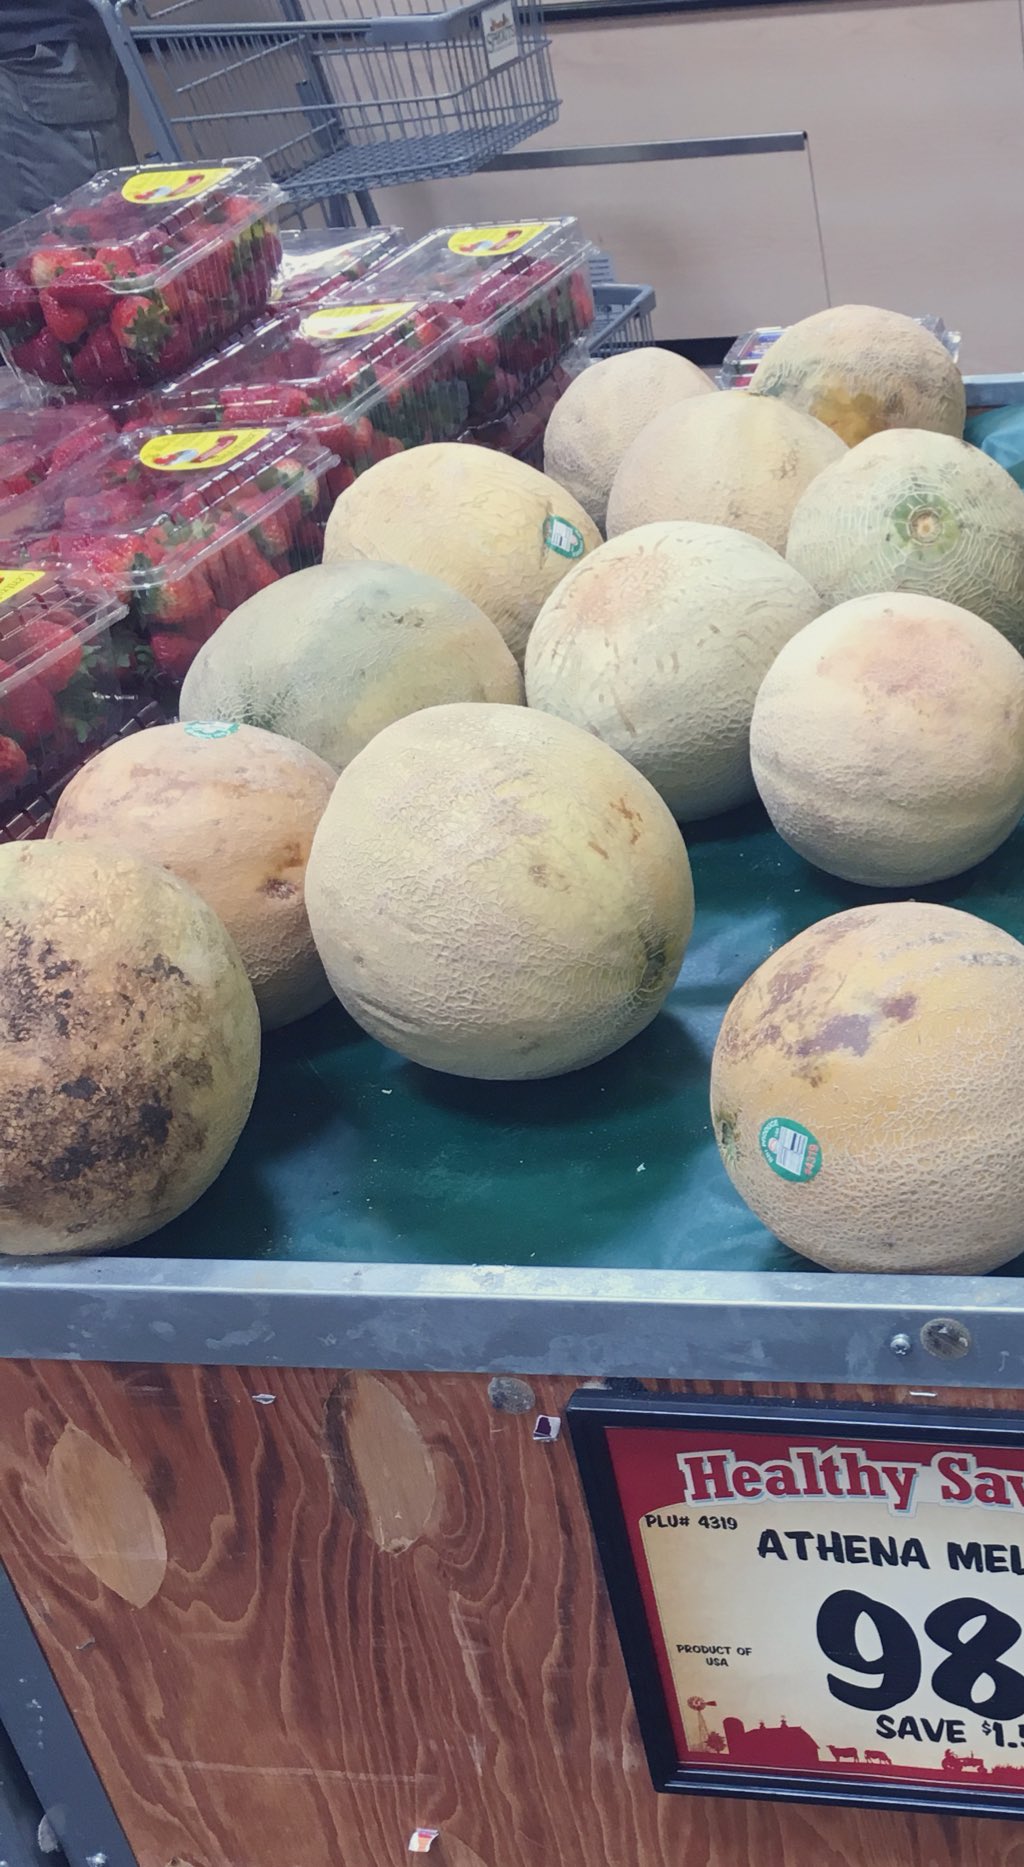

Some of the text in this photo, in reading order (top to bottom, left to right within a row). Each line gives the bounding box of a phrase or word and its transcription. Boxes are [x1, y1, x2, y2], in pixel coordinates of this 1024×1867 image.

[683, 1450, 919, 1512] Healthy
[644, 1514, 738, 1530] PLU# 4319
[756, 1529, 931, 1569] ATHENA
[676, 1644, 752, 1656] PRODUCT OF
[705, 1657, 729, 1667] USA
[875, 1714, 967, 1743] SAVE
